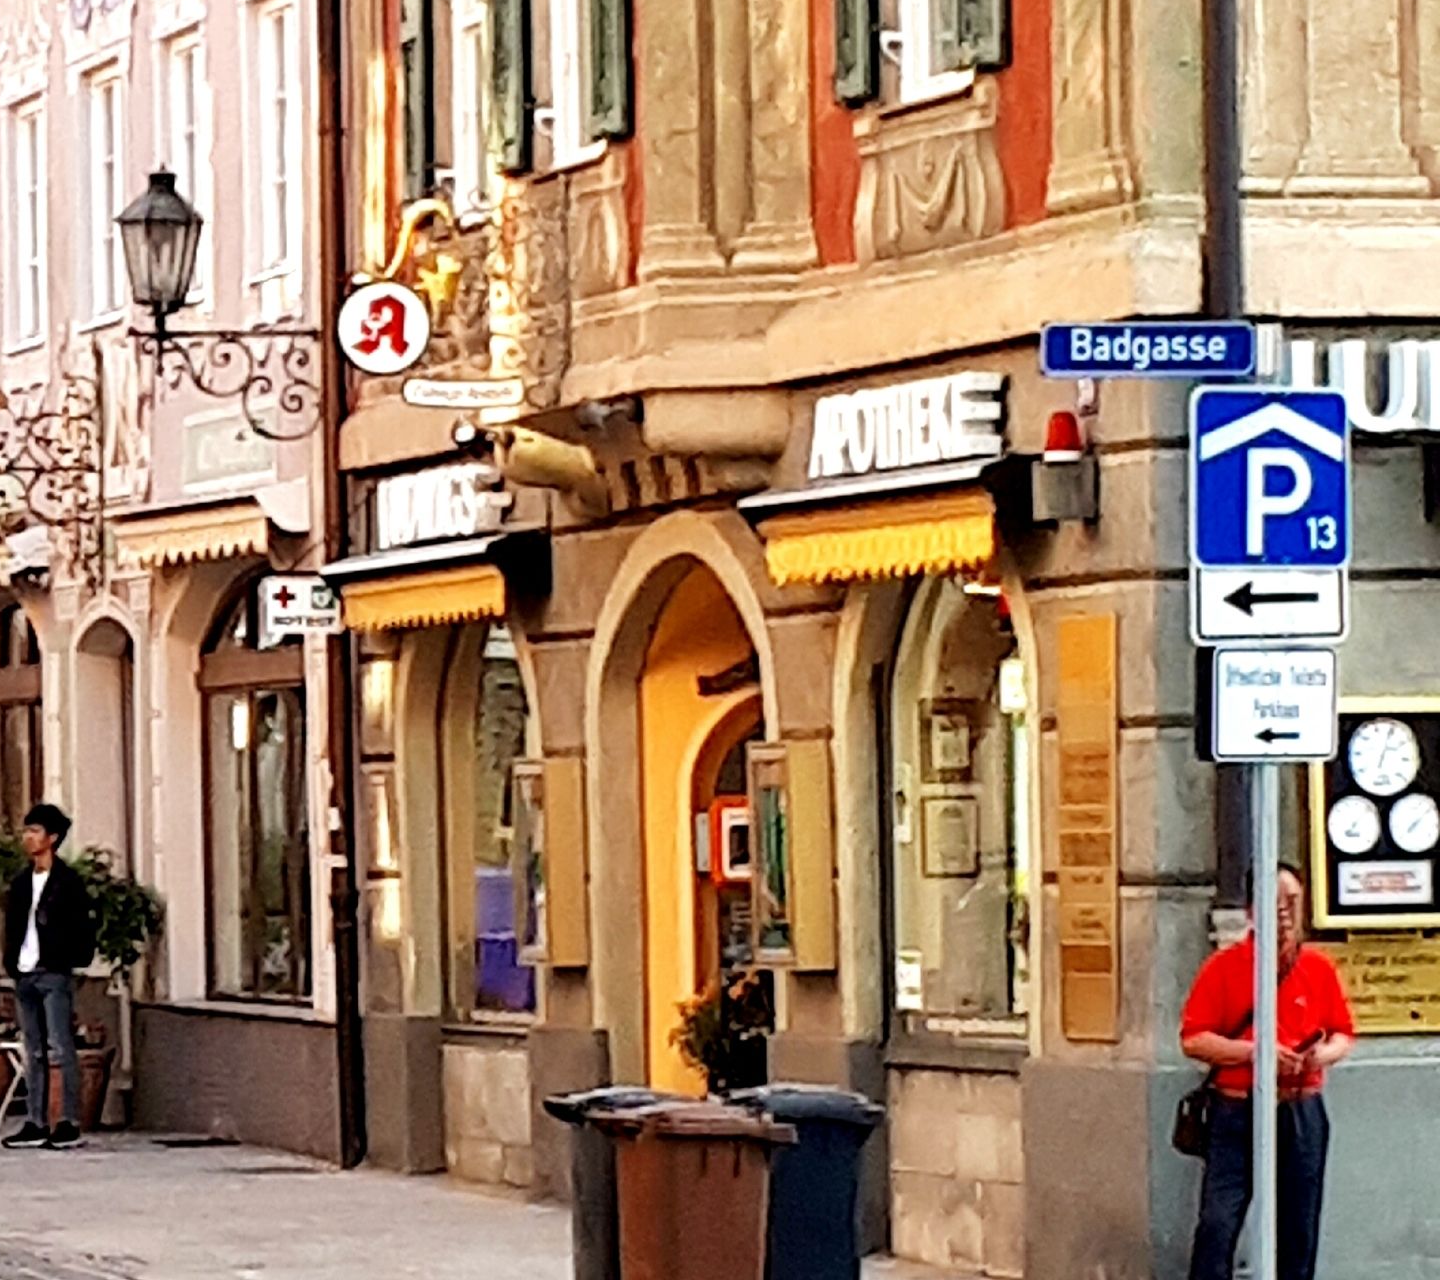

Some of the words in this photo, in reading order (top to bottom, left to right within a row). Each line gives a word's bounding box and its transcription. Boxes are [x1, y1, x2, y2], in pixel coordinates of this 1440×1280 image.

[1070, 327, 1227, 370] Badgasse
[808, 370, 1003, 479] APOTHEKE
[1246, 447, 1312, 556] P
[1307, 515, 1338, 552] 13
